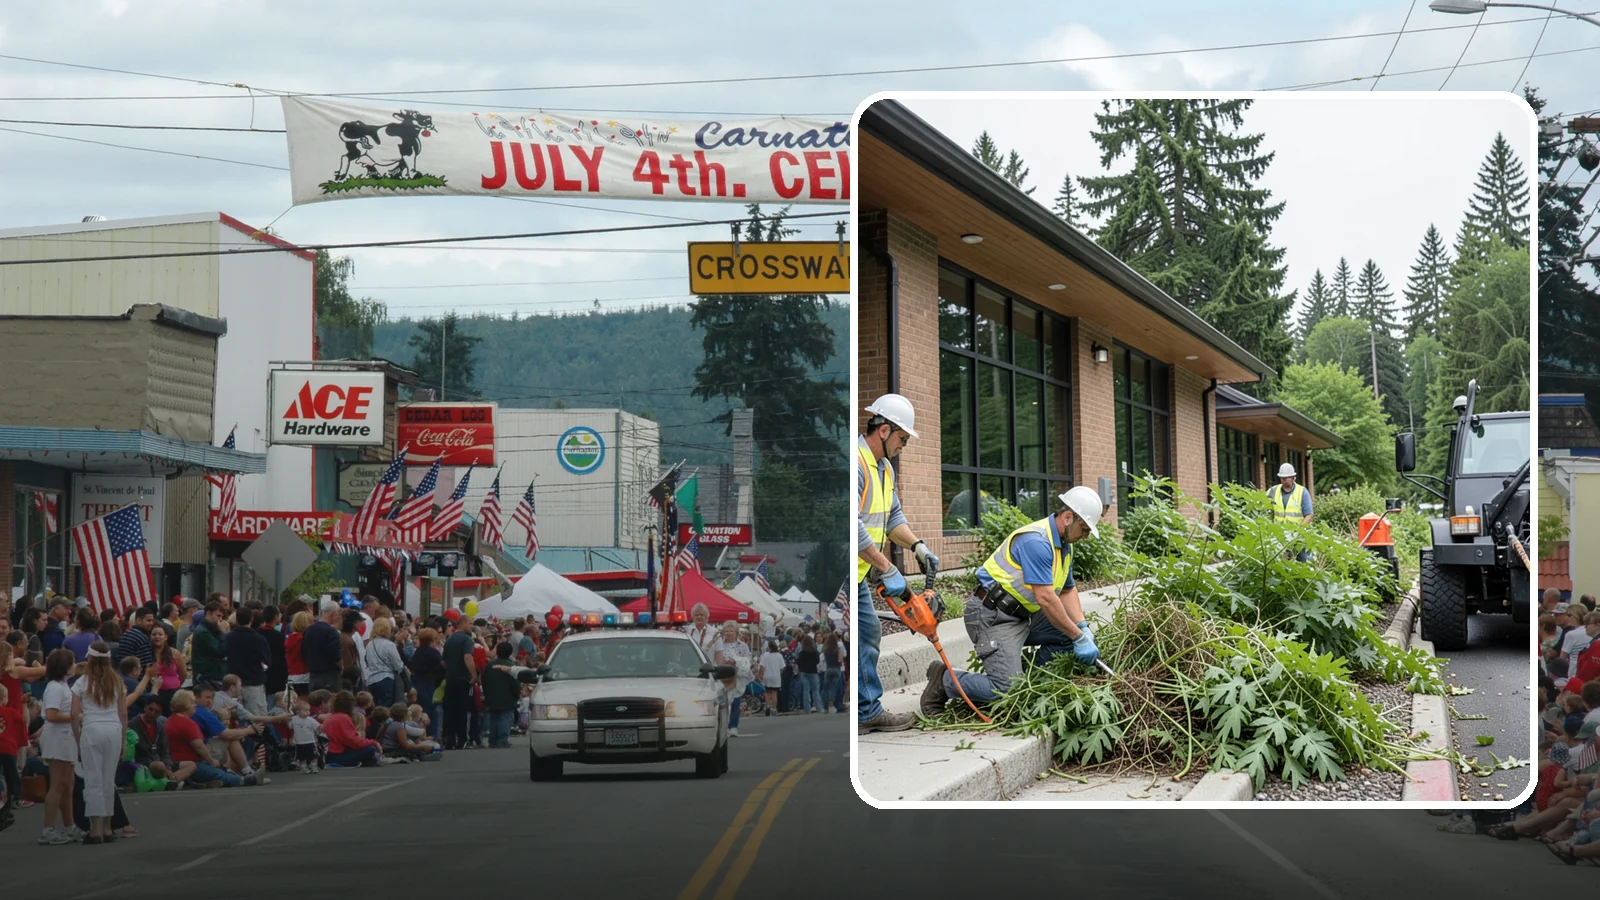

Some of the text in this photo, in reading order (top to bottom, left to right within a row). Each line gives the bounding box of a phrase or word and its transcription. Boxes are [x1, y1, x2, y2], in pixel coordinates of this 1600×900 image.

[481, 141, 604, 193] JULY
[632, 150, 746, 198] 4th.
[697, 254, 850, 280] CROSSWA
[282, 380, 373, 419] ACE
[406, 409, 452, 422] CEDAR
[283, 421, 370, 436] Hardware
[95, 485, 124, 495] Vincent
[126, 485, 136, 495] de
[137, 486, 155, 495] Paul
[212, 516, 331, 535] HARDARE
[688, 526, 741, 535] CRNATION
[699, 535, 730, 543] GLASS
